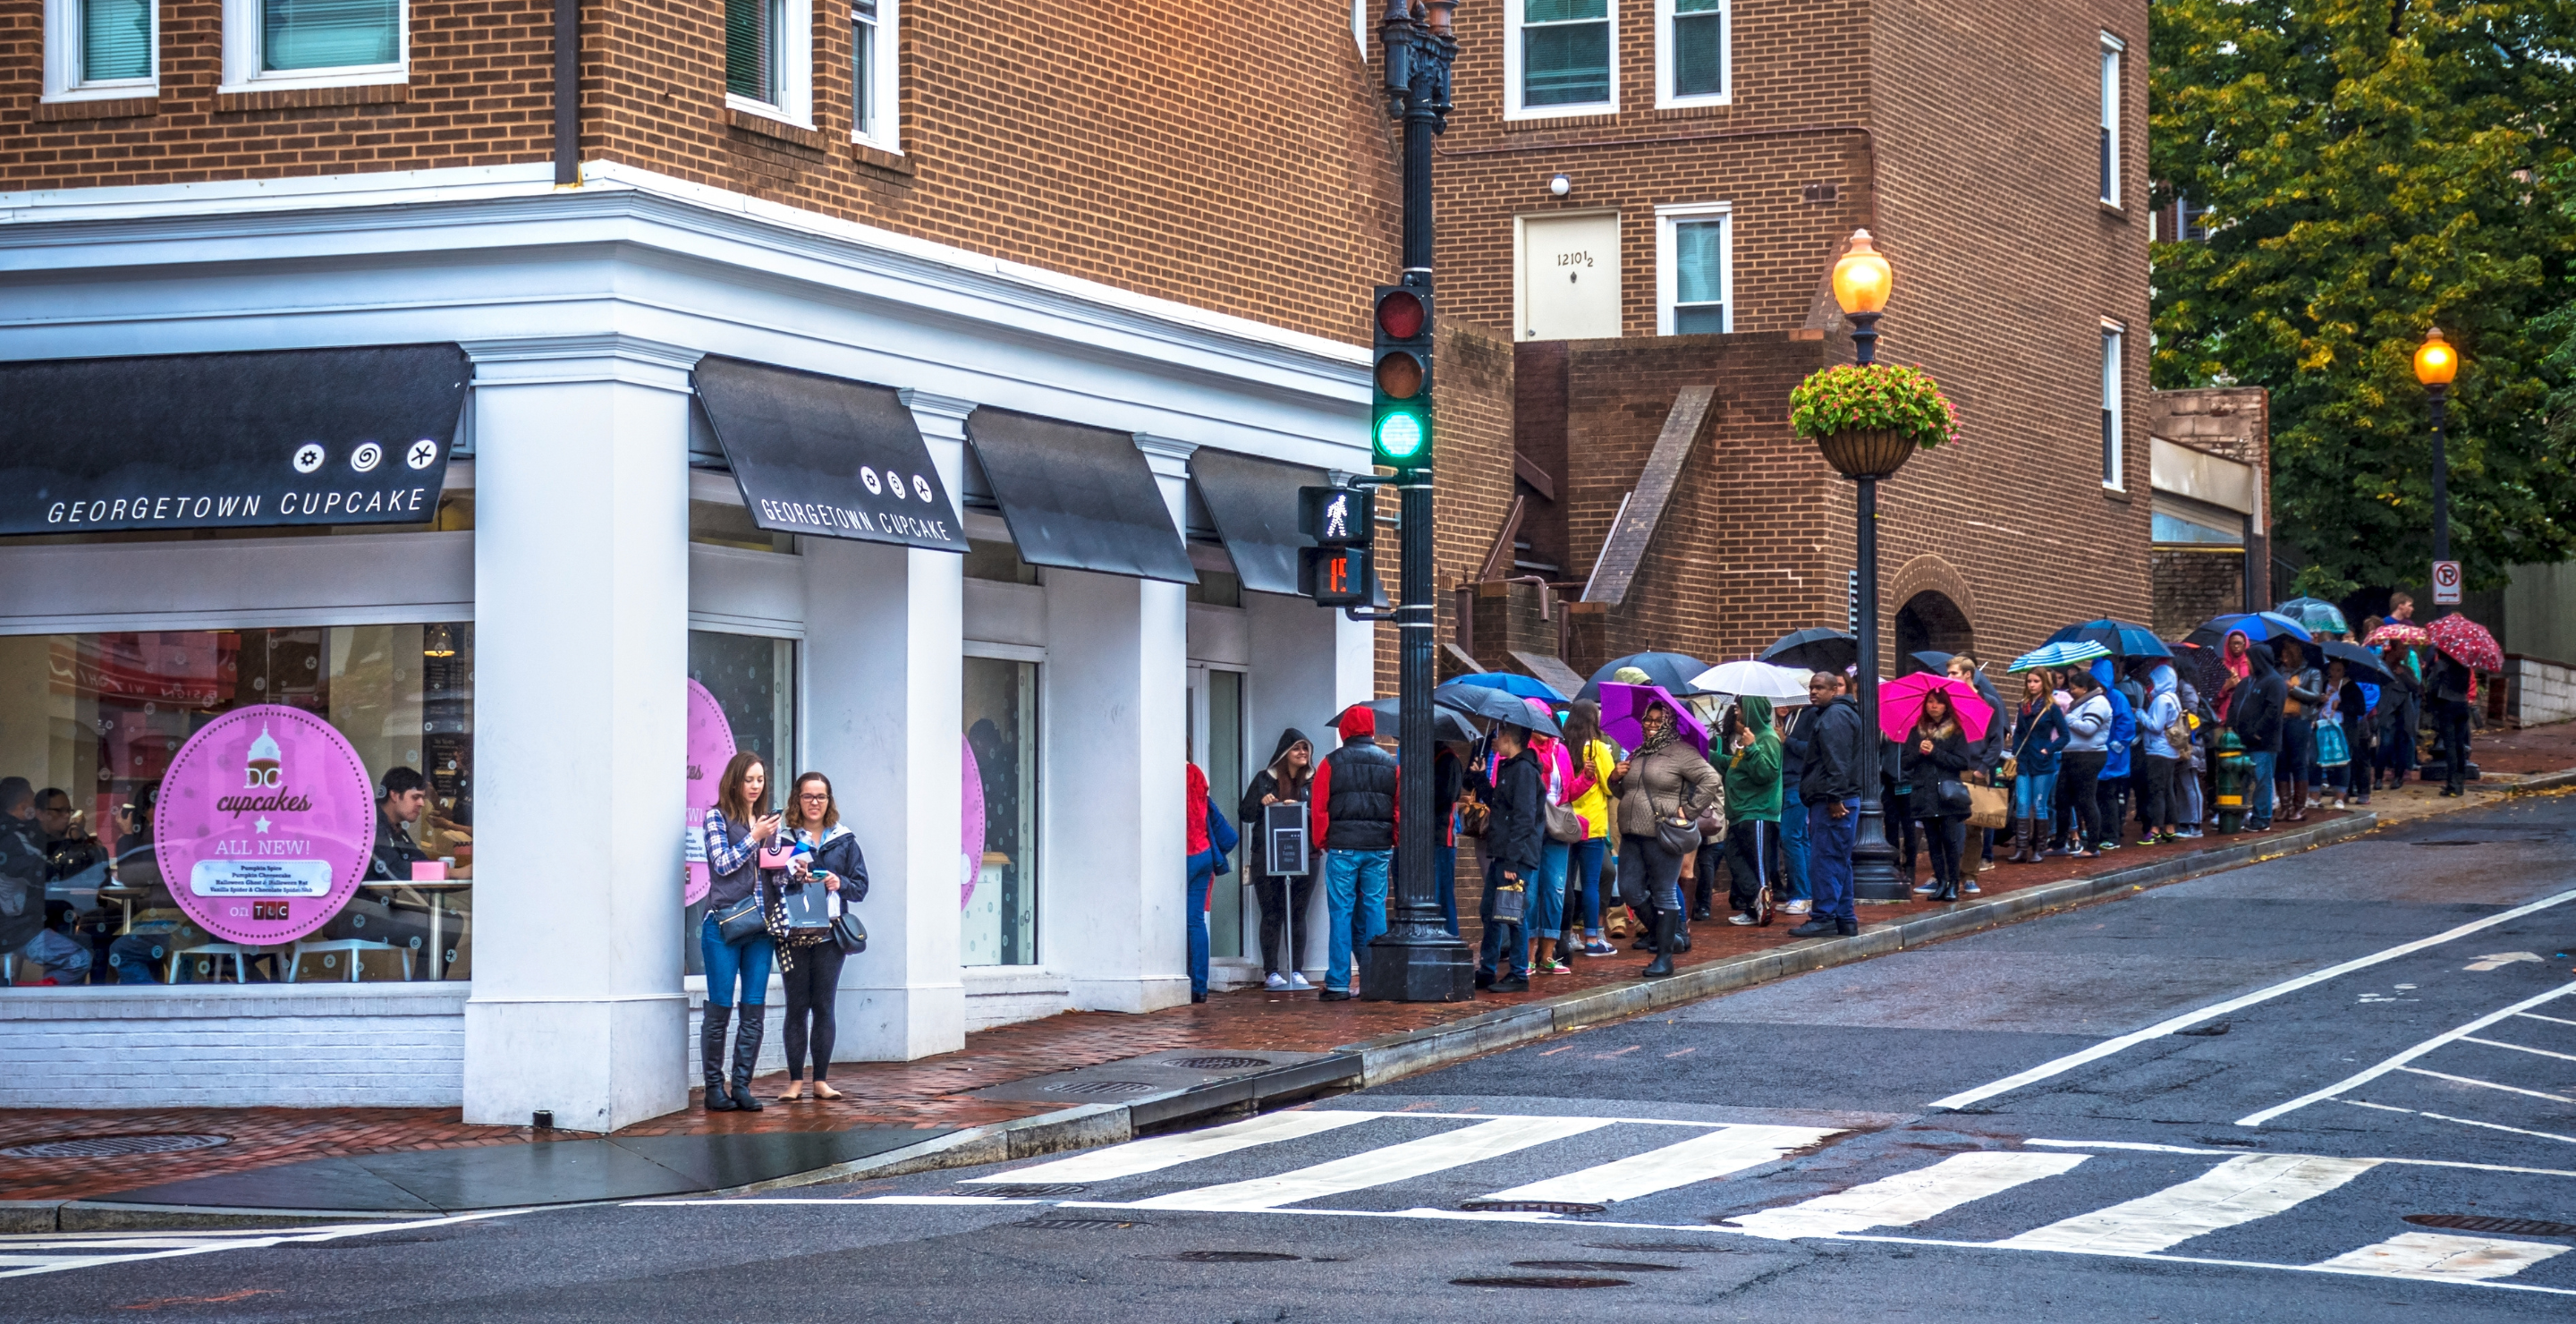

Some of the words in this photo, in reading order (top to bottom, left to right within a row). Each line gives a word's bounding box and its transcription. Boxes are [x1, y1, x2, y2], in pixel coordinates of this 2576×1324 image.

[47, 495, 262, 524] GEORGETOWN
[281, 488, 426, 515] CUPCAKE
[761, 498, 875, 531] GEORGETOWN
[879, 512, 952, 541] CUPCAKE
[243, 768, 283, 790] DC
[216, 785, 313, 819] cupcakes
[215, 840, 252, 855] ALL
[258, 840, 310, 855] NEW!
[229, 906, 250, 917] on
[254, 904, 288, 917] TLC
